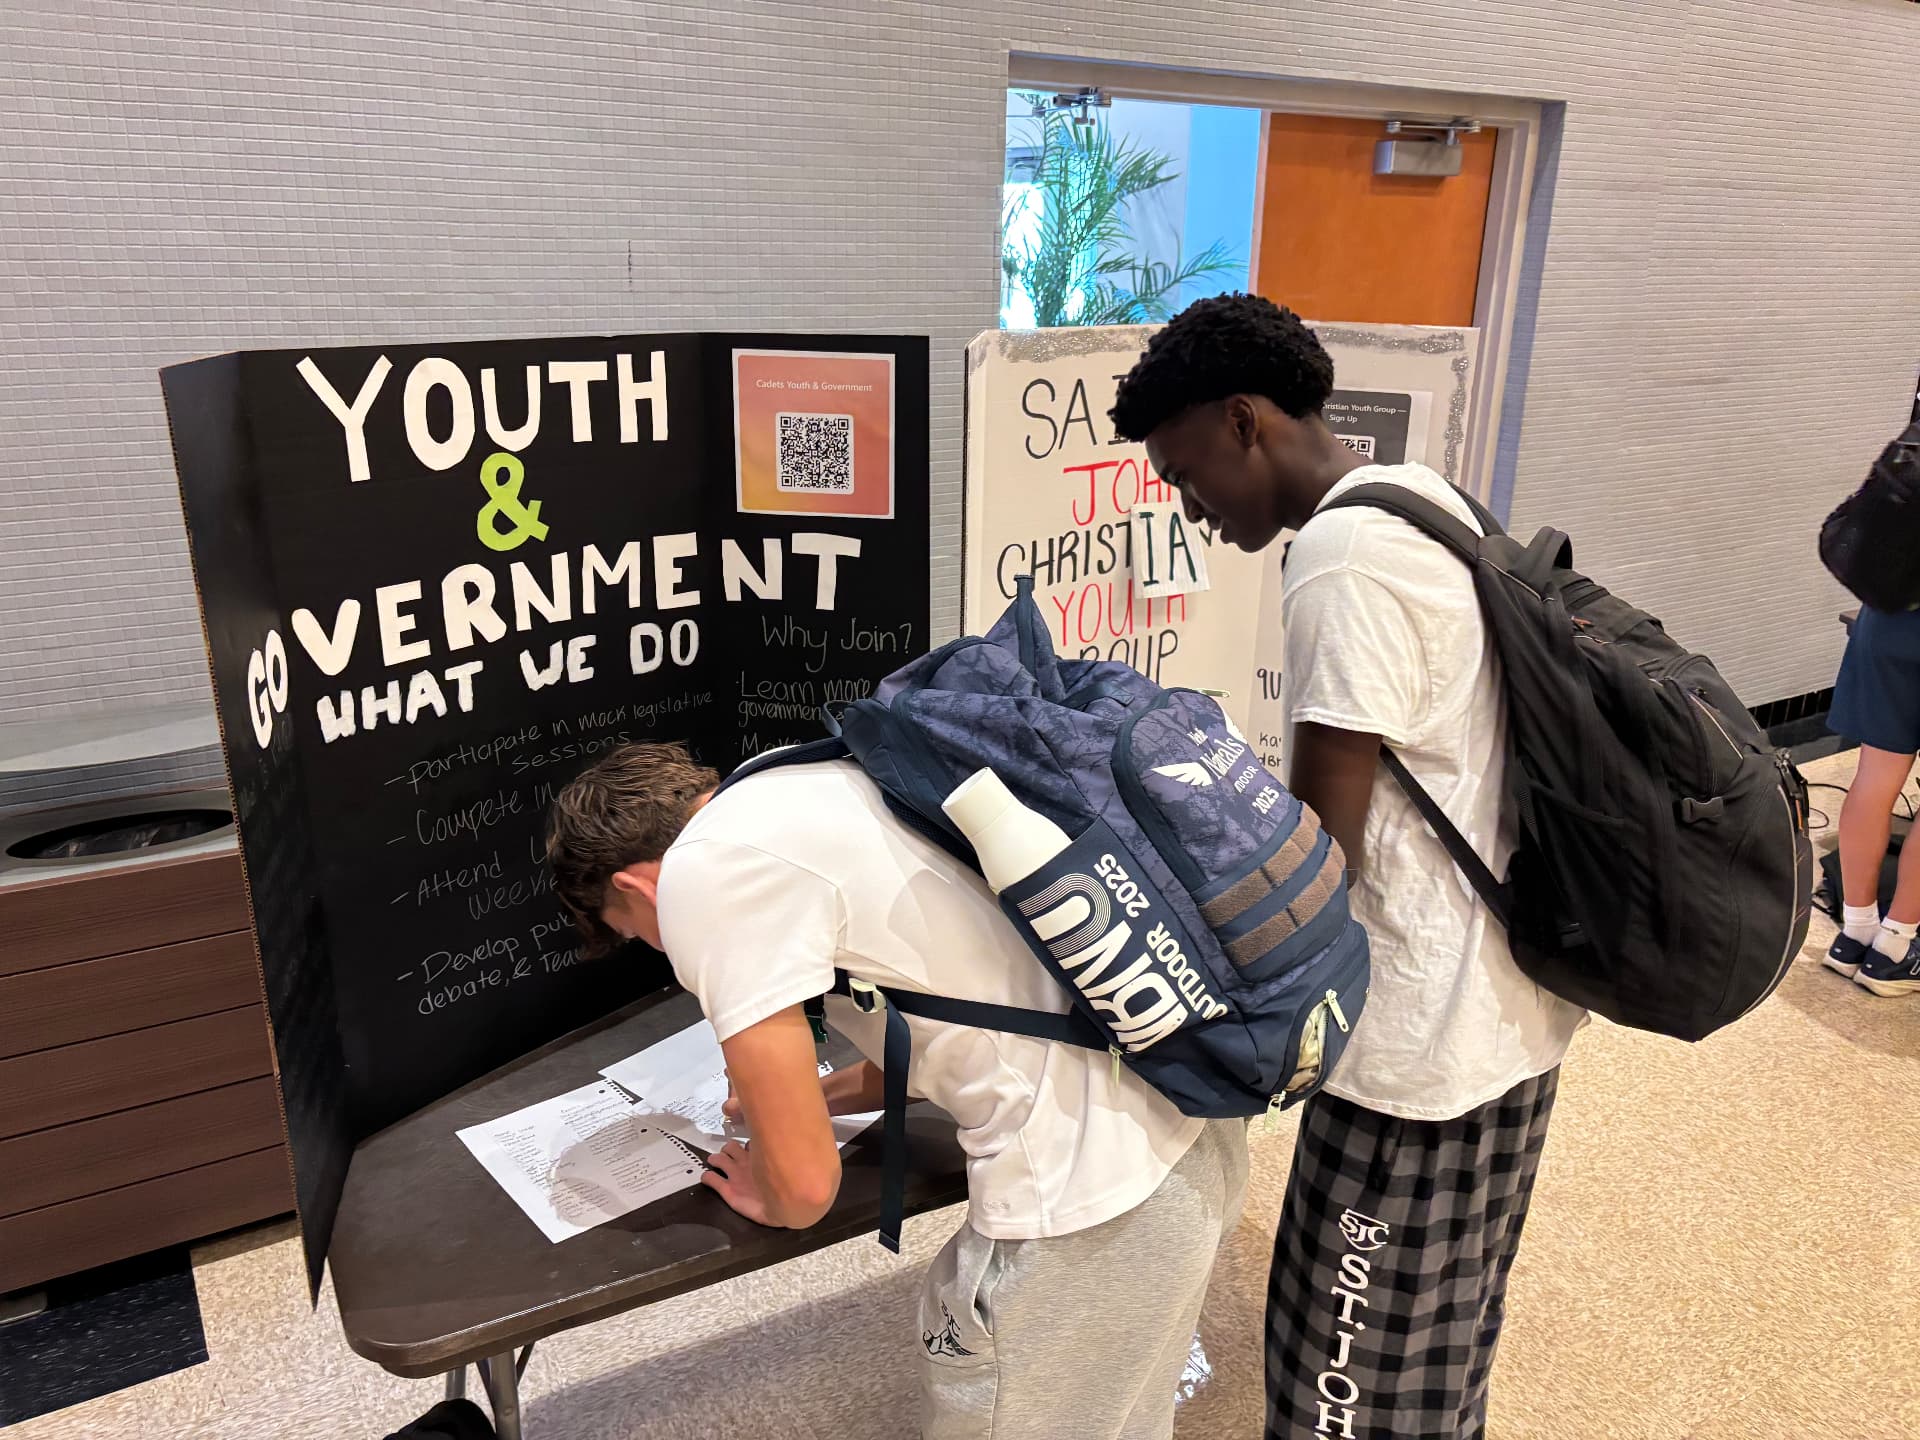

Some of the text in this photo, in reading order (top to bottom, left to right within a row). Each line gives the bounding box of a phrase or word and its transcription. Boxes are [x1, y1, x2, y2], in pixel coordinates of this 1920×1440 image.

[755, 379, 873, 392] Cadets Youth & Government
[1351, 402, 1372, 412] Youth
[1373, 405, 1397, 414] Group
[296, 350, 668, 482] YOUTH
[1329, 414, 1358, 423] Sign Up
[477, 452, 549, 551] &
[1063, 459, 1173, 526] JOH
[762, 615, 912, 673] Why Join?
[317, 619, 699, 743] WHAT WE DO
[741, 671, 815, 704] Learn
[633, 691, 713, 727] legislative
[738, 701, 822, 728] governmen
[512, 731, 633, 775] sessions
[417, 789, 523, 844] Compete
[1252, 786, 1280, 814] 2025
[418, 851, 503, 906] Attend
[1093, 853, 1150, 918] 2025
[421, 938, 519, 984] Develop
[1338, 1211, 1389, 1248] SJC
